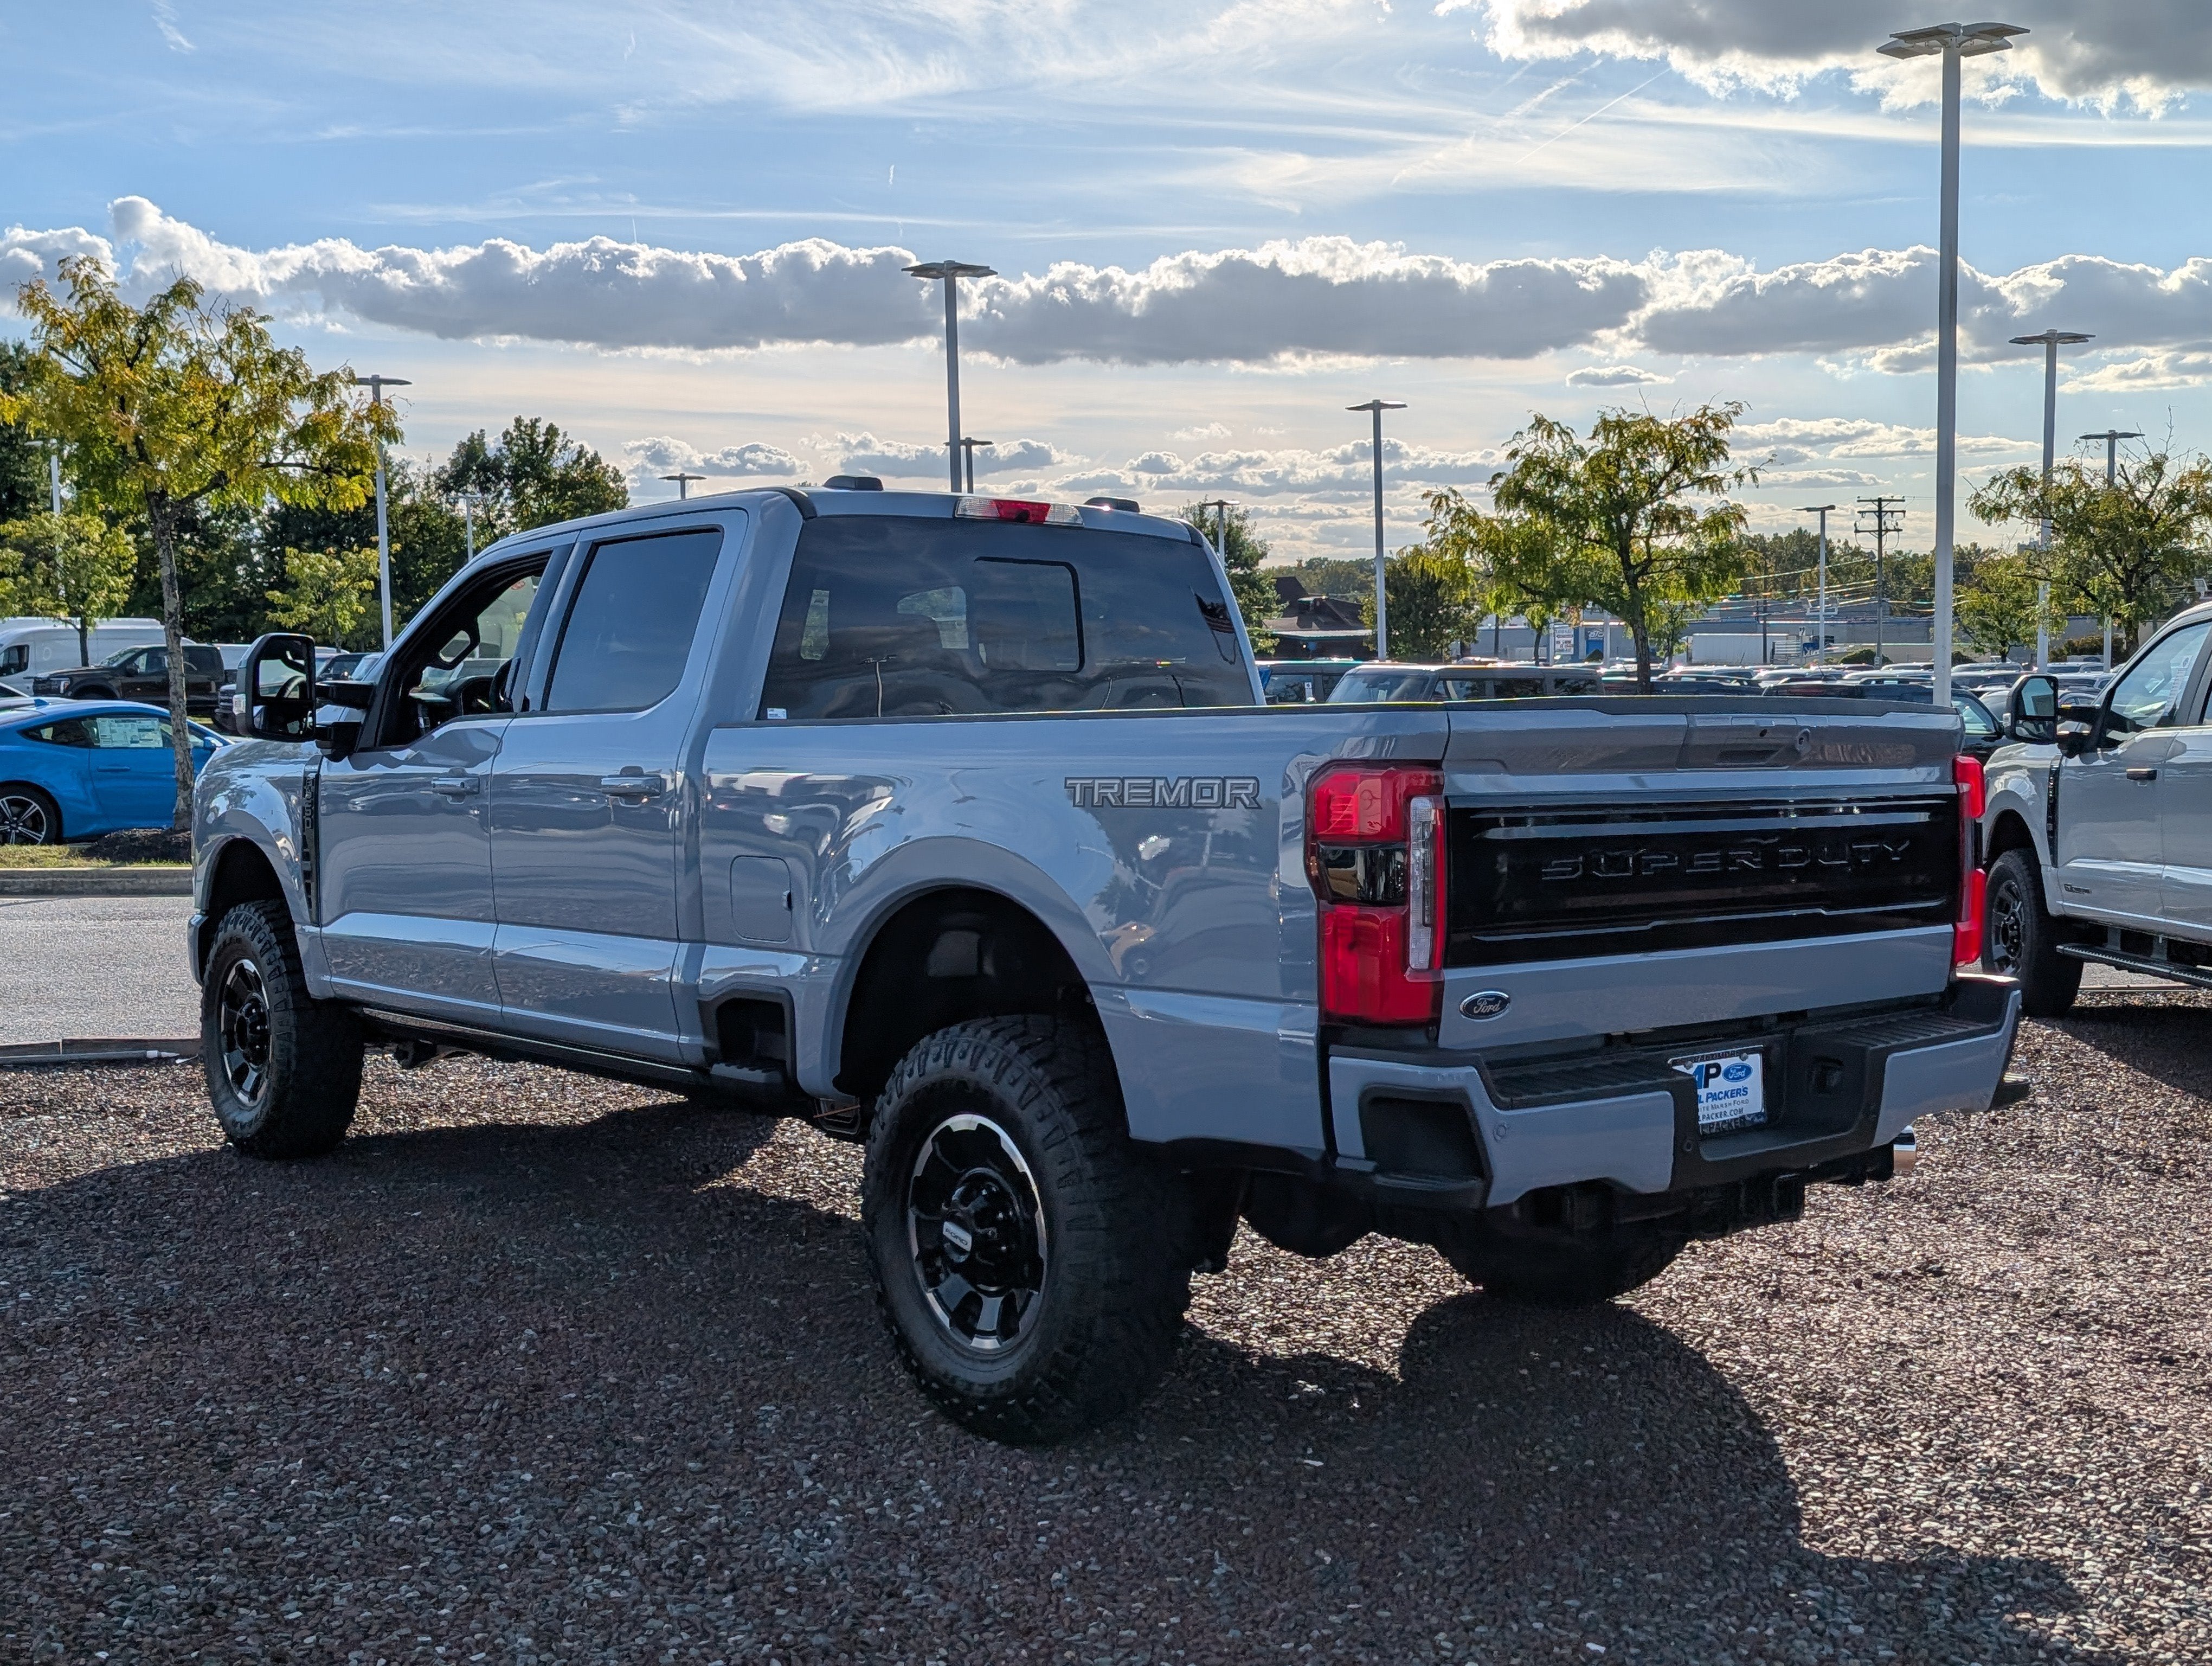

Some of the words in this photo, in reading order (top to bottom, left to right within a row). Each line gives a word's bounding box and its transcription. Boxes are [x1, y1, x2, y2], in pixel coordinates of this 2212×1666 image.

[1065, 776, 1262, 810] TREMOR
[1542, 850, 1761, 880] SUPER
[1778, 841, 1909, 868] DUTY
[1473, 997, 1501, 1014] Ford
[1698, 1094, 1704, 1104] L
[1706, 1086, 1748, 1103] PACKER'S
[1699, 1107, 1744, 1122] PACKER.COM
[1711, 1102, 1732, 1110] MARSH
